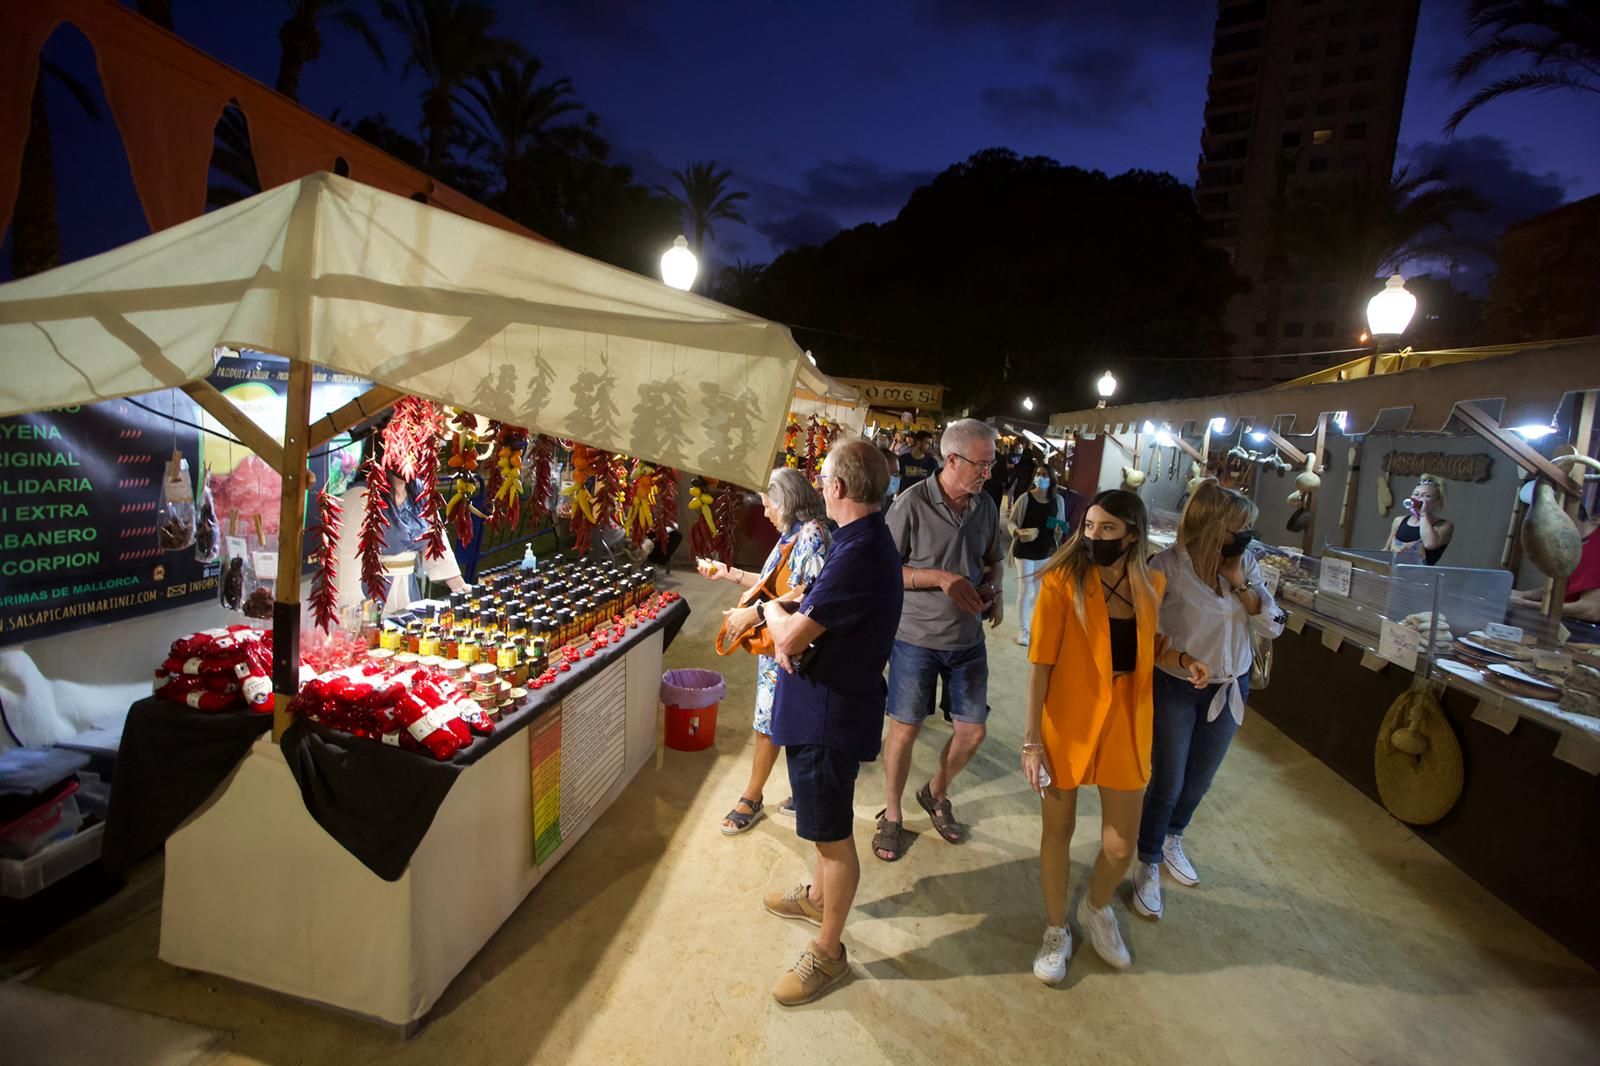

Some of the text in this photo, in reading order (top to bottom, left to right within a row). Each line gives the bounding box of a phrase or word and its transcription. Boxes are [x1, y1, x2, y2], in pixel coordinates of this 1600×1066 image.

[0, 424, 62, 440] YENA
[0, 452, 80, 468] IGINAL
[0, 478, 93, 495] LIDARIA
[16, 504, 89, 521] EXTRA
[52, 587, 70, 599] DE
[73, 576, 140, 595] MALLORCA
